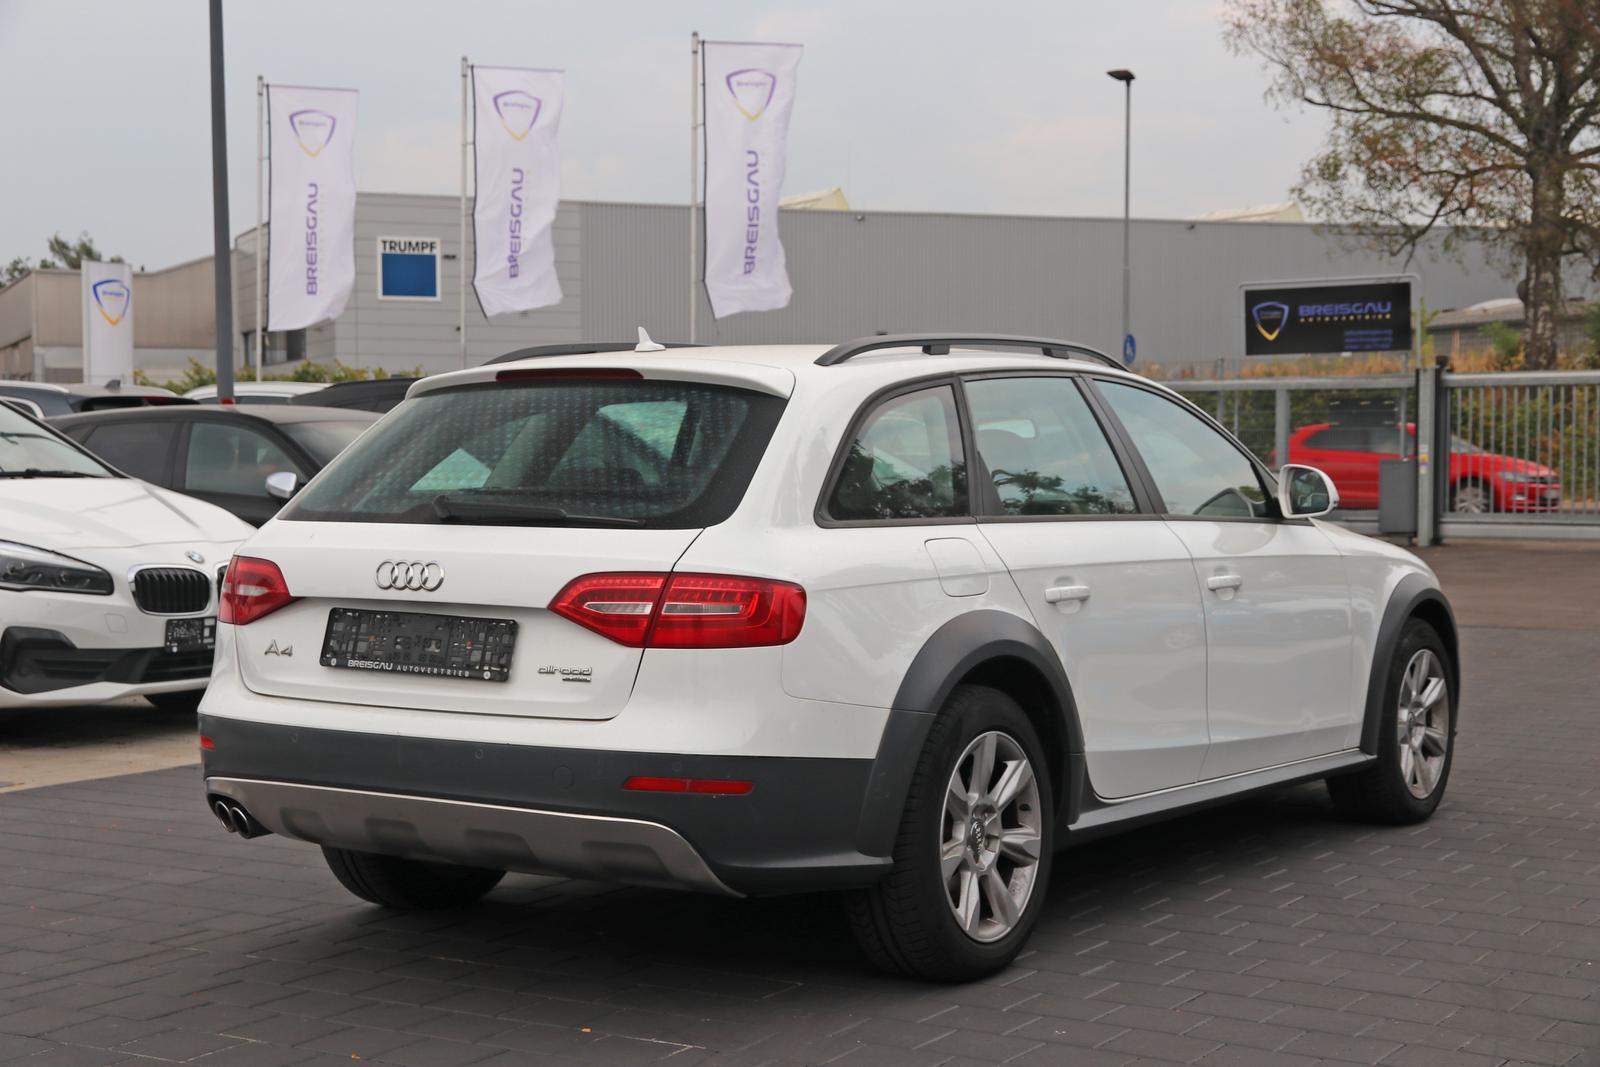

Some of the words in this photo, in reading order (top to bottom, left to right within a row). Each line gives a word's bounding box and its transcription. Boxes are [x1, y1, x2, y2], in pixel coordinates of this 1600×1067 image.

[744, 150, 760, 275] BREISGAU
[306, 182, 318, 295] BREISGAU
[381, 240, 437, 252] TRUMPF
[1299, 302, 1391, 316] BREISGAU
[264, 639, 294, 656] A4
[347, 659, 394, 670] BREISGAU
[396, 664, 470, 677] AUTOVERTRIEB
[537, 665, 592, 676] allroad
